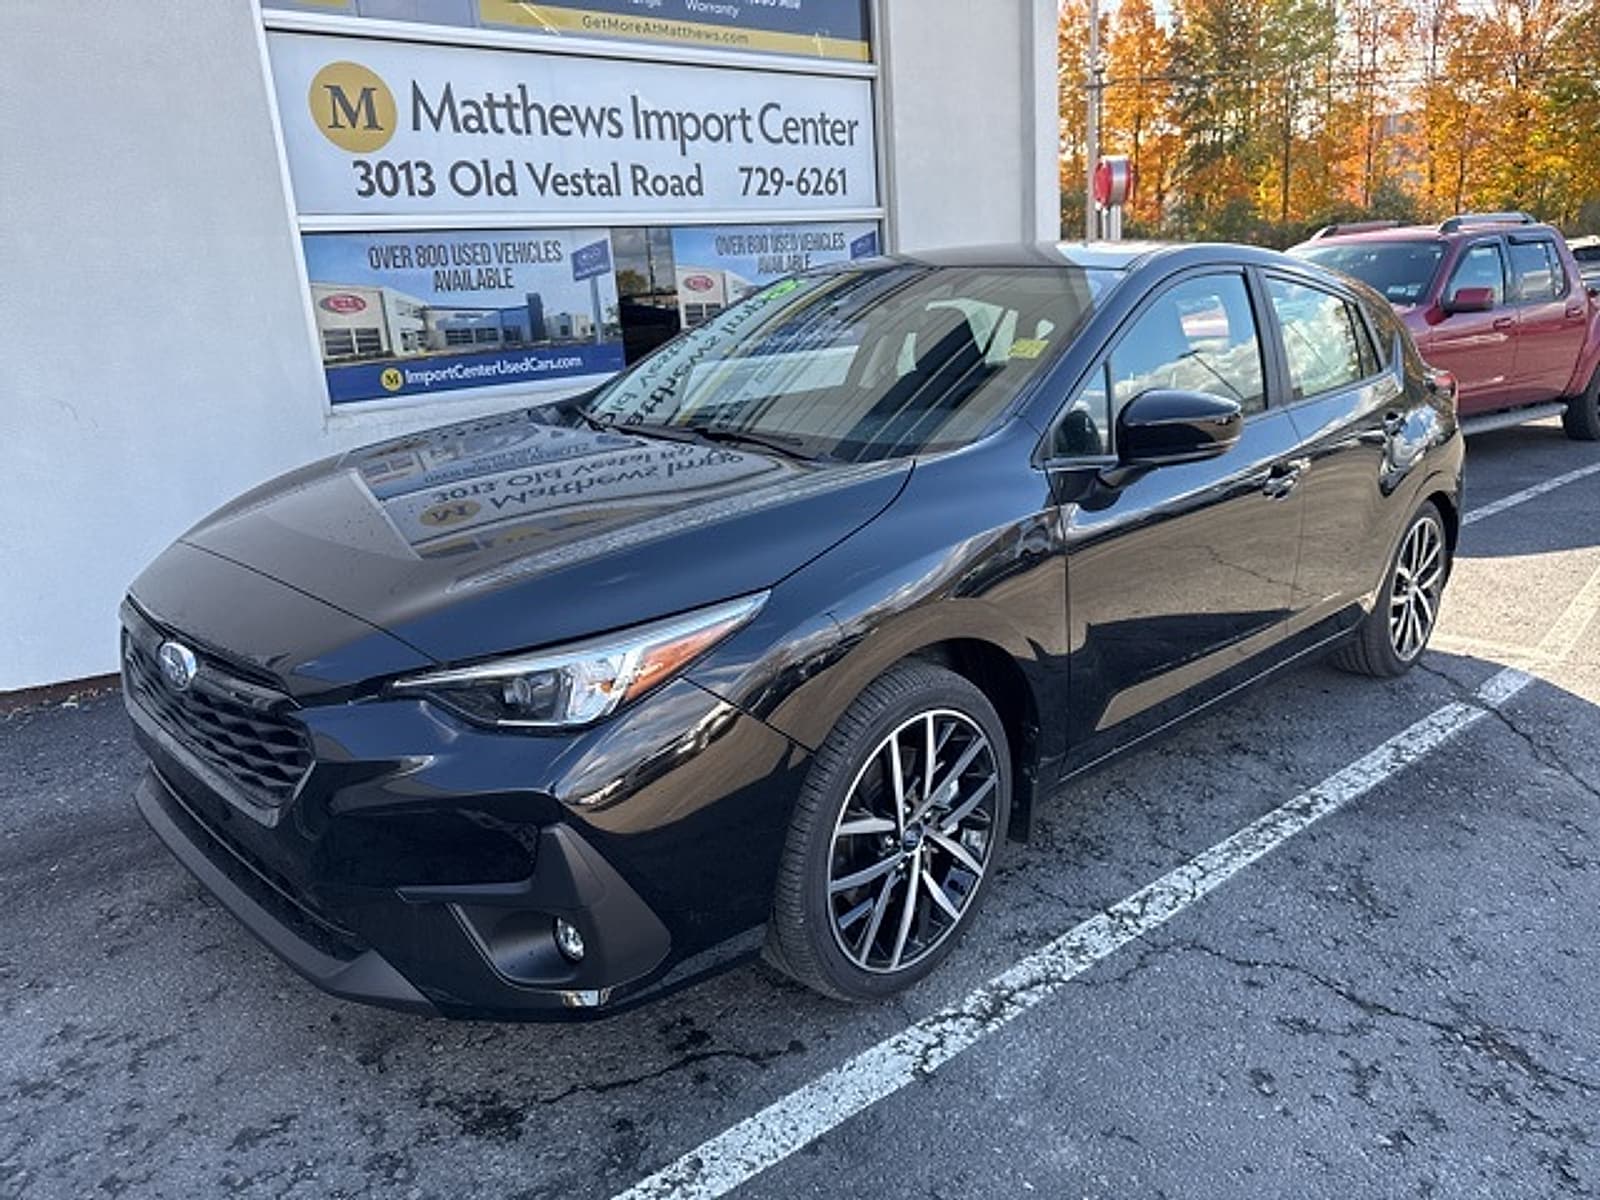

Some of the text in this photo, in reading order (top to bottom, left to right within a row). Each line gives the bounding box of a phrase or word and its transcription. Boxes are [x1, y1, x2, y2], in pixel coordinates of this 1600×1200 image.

[582, 15, 749, 44] GetMoreAtMatthews.com
[324, 85, 384, 131] M
[411, 79, 857, 156] Matthews Import Center
[352, 159, 848, 197] 3013 Old Vestal Road 729-6261
[368, 240, 562, 269] OVER 800 USED VEHICLES
[801, 232, 846, 252] VEHICLES
[434, 267, 515, 292] AVAILABLE
[405, 356, 583, 385] ImportCenterUsedCars.com
